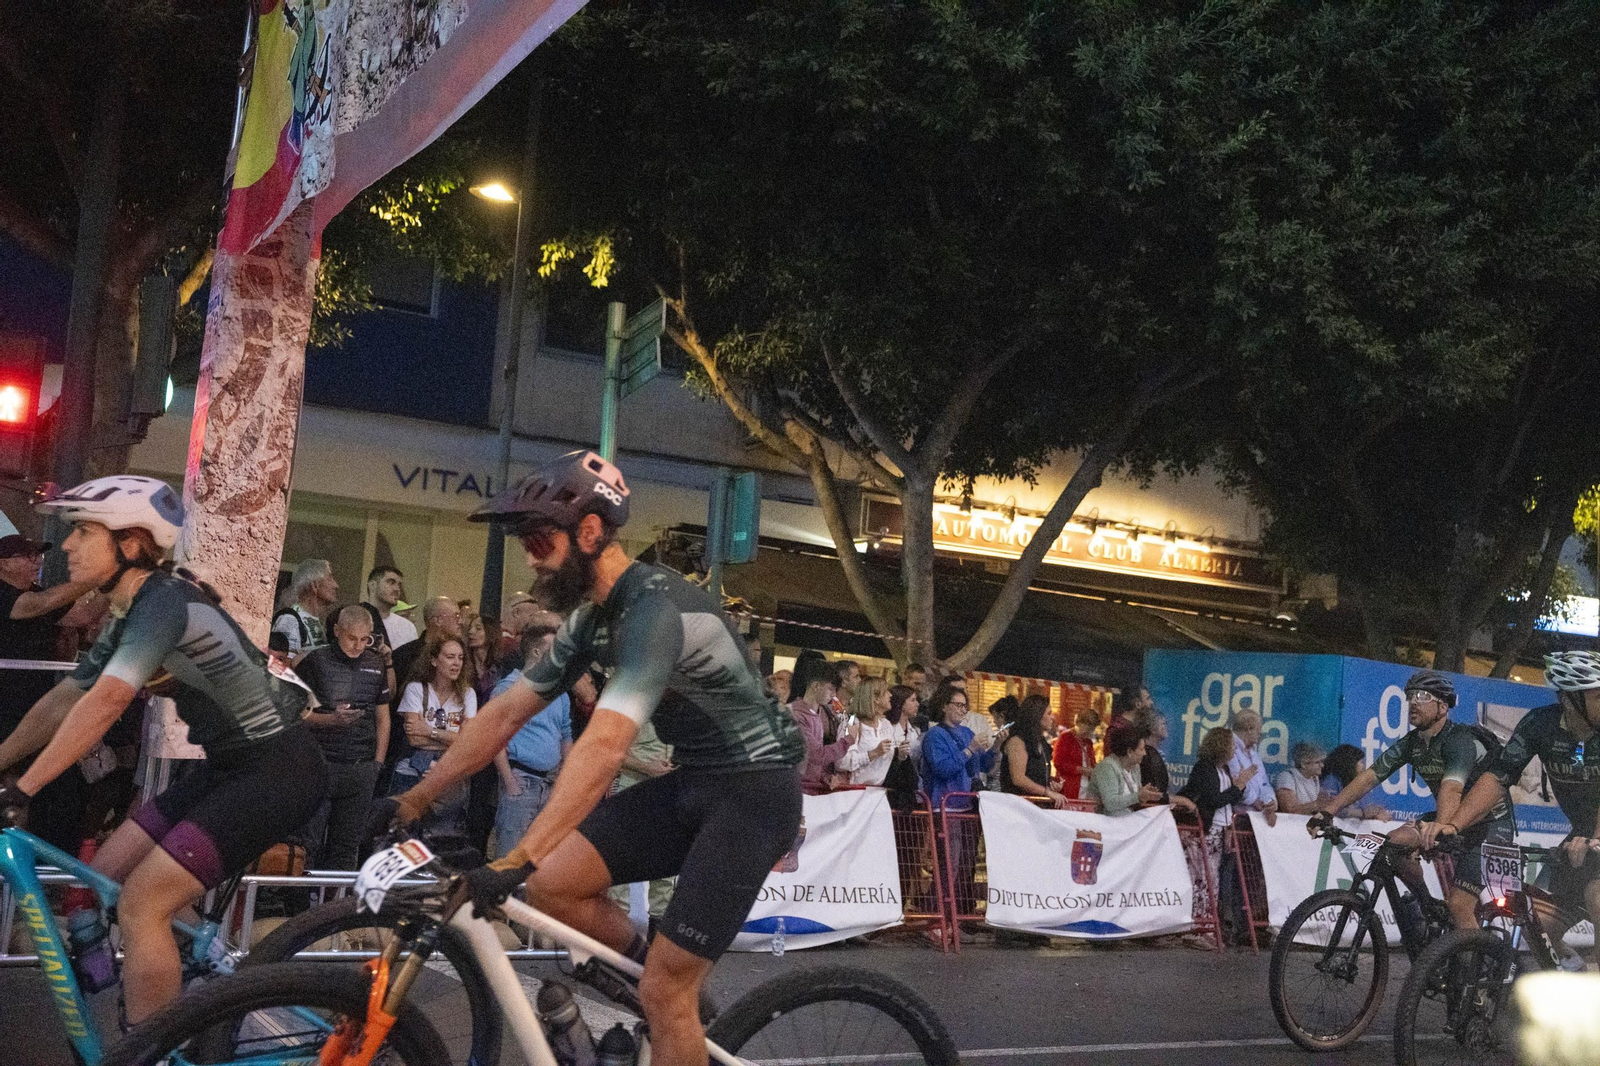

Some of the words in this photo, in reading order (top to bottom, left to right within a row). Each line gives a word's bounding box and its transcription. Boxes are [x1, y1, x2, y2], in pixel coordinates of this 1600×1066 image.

[594, 481, 623, 507] POC
[935, 517, 1073, 555] AUTOMOIL
[1087, 535, 1143, 563] CLUB
[1200, 672, 1285, 729] gar
[793, 884, 815, 903] DE
[818, 883, 898, 904] ALMERÍA
[988, 887, 1091, 909] DIPUTACIÓN
[1096, 892, 1115, 907] DE
[1119, 888, 1183, 907] ALMERÍA
